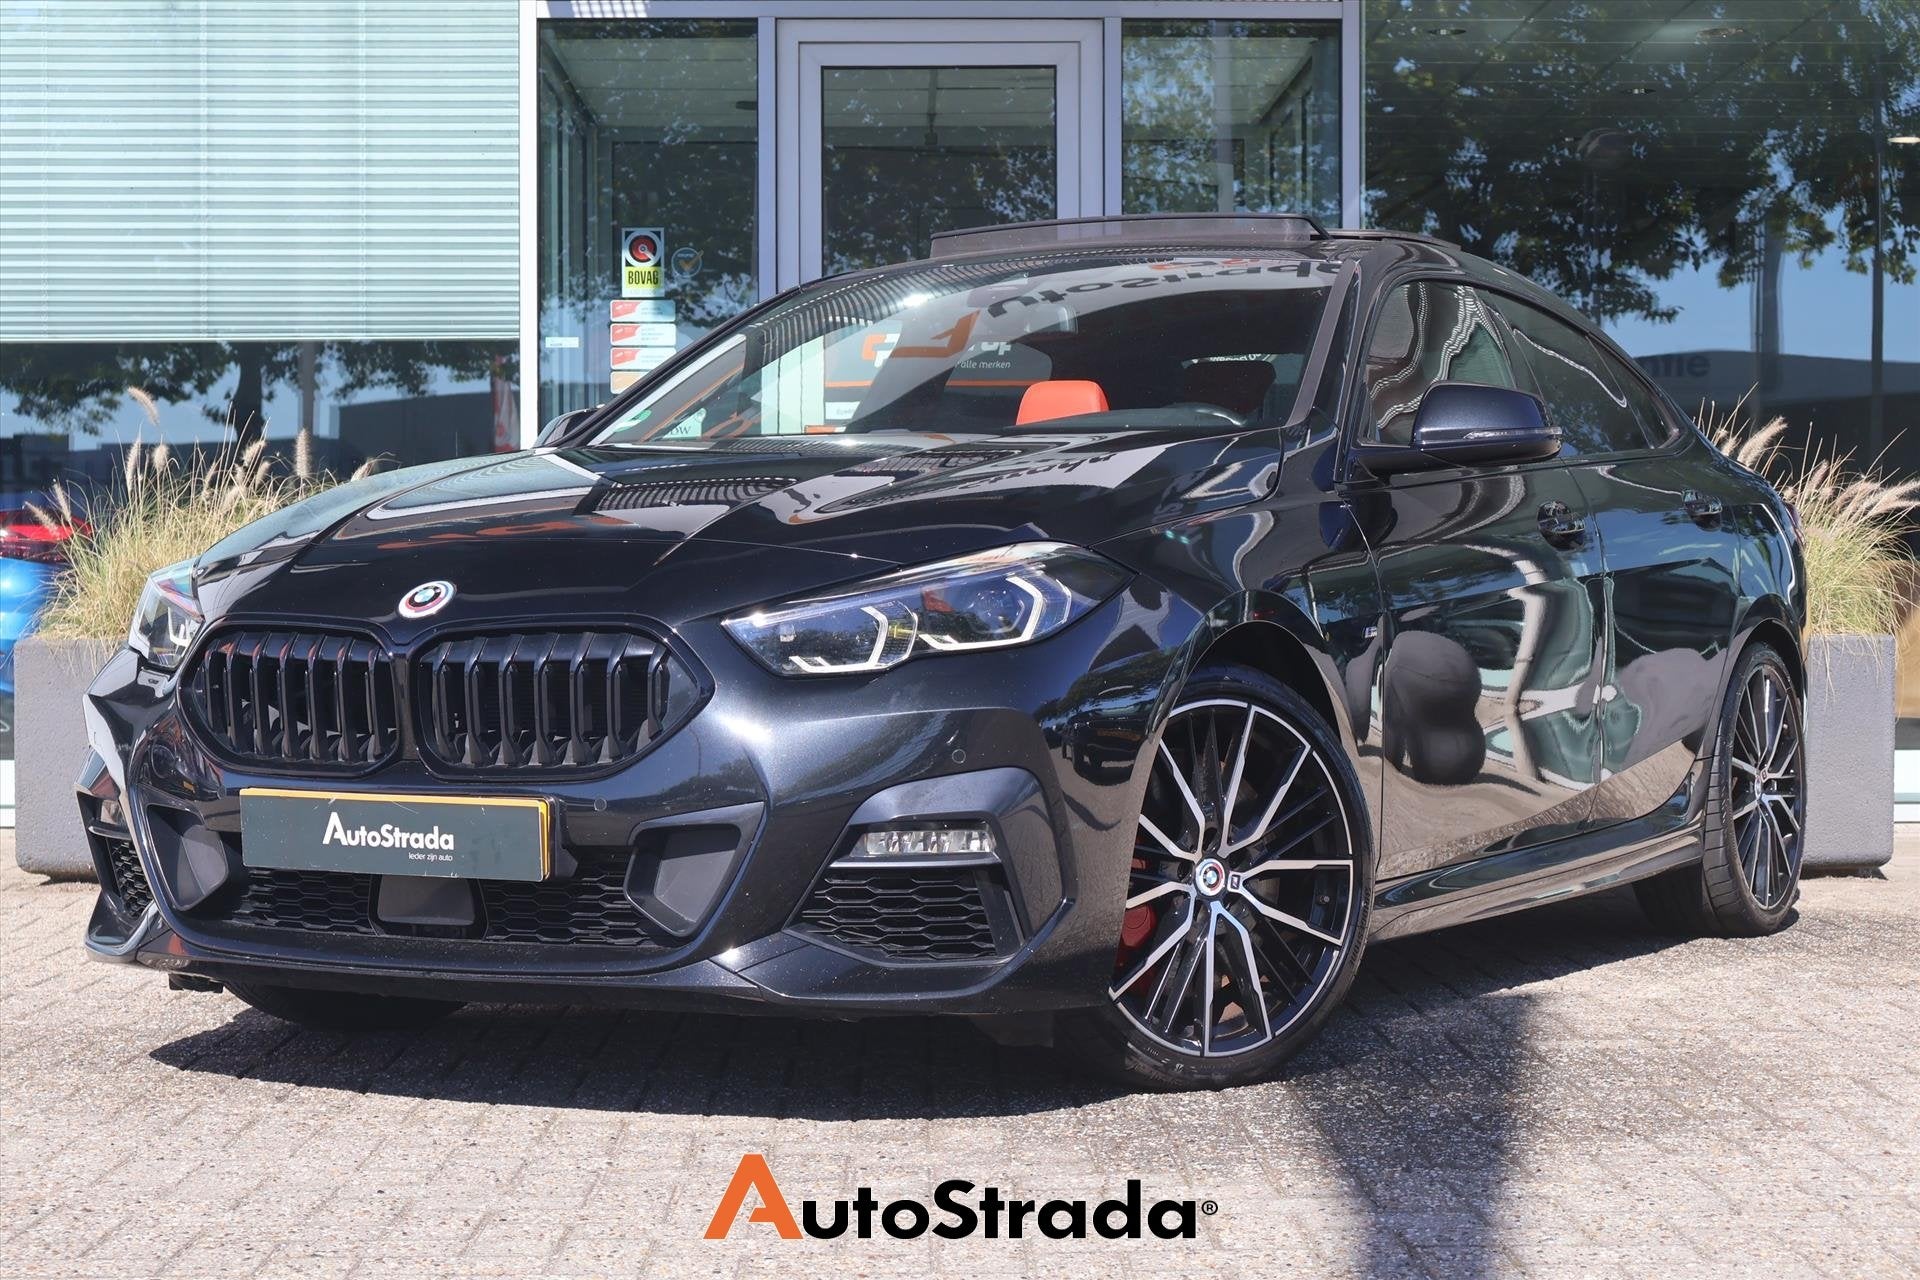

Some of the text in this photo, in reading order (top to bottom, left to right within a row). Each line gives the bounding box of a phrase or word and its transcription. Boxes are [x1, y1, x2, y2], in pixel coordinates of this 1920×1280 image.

[628, 270, 659, 285] BOVAG
[960, 359, 1011, 369] alle merken
[322, 811, 455, 850] AutoStrada
[438, 854, 453, 862] auto
